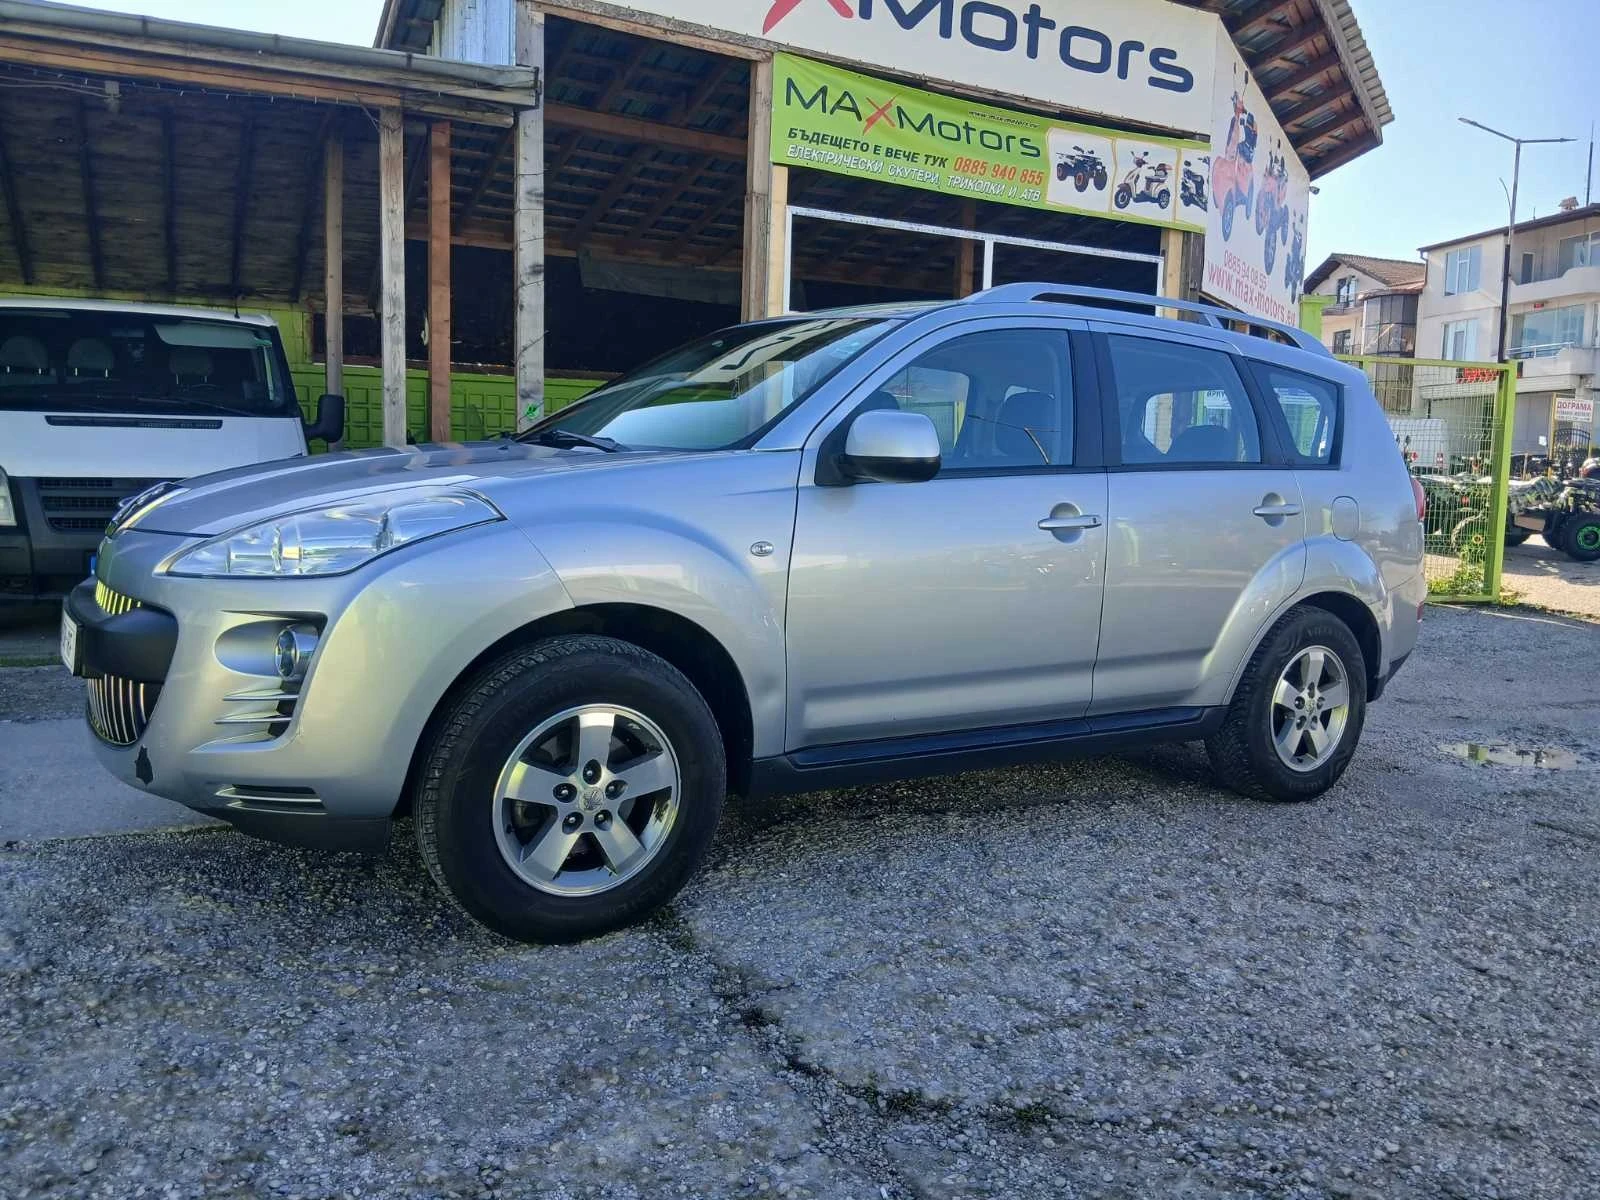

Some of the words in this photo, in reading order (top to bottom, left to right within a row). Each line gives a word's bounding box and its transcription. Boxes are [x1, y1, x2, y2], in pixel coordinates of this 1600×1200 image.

[785, 77, 1041, 158] MAXMotors
[787, 127, 870, 153] БЪДЕЩЕТО
[873, 144, 883, 156] Е
[885, 147, 921, 163] ВЕЧЕ
[924, 153, 949, 169] ТУК
[787, 144, 885, 173] ЕЛЕКТРИЧЕСКИ
[948, 175, 1006, 196] ТРИКОЛКИ
[1007, 185, 1018, 199] И
[1019, 188, 1041, 202] АТВ
[953, 156, 989, 177] 0885
[991, 163, 1017, 181] 940
[1020, 168, 1045, 186] 855
[1208, 261, 1296, 327] www.max-motors.eu
